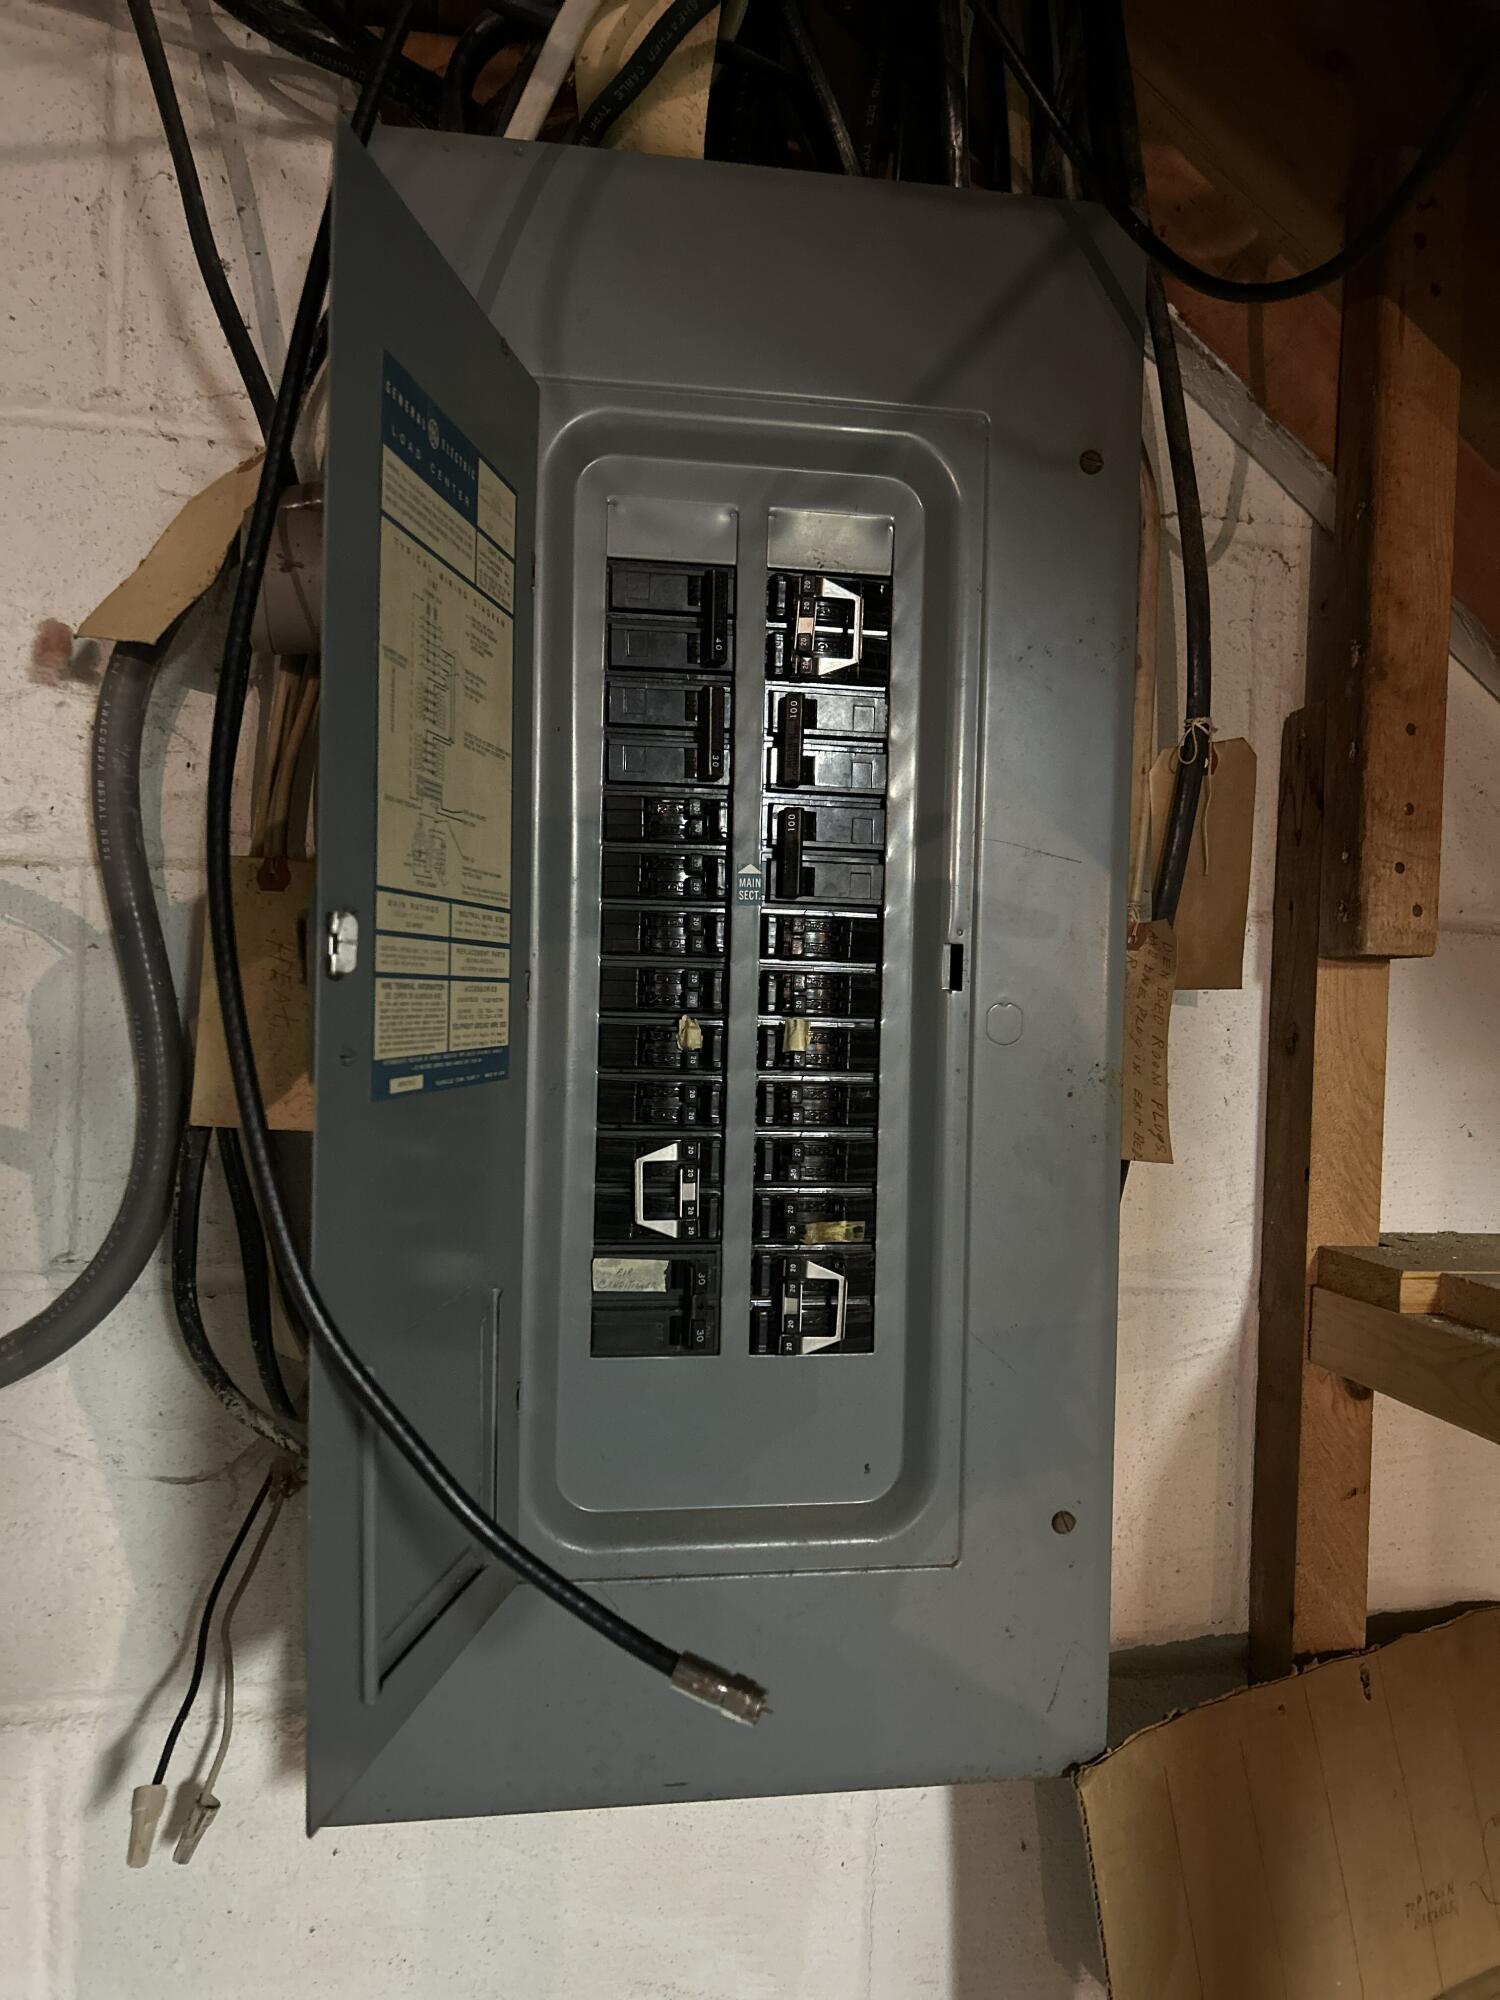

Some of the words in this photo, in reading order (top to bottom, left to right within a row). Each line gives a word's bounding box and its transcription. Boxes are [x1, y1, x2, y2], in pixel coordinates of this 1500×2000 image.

[614, 65, 646, 101] CABLE
[714, 636, 722, 652] 40
[712, 754, 719, 768] 30
[787, 813, 796, 832] 100
[739, 878, 761, 888] MAIN
[738, 890, 761, 900] SECT.
[1151, 1035, 1165, 1088] ROOM
[697, 1272, 706, 1286] 30
[696, 1330, 704, 1342] 30
